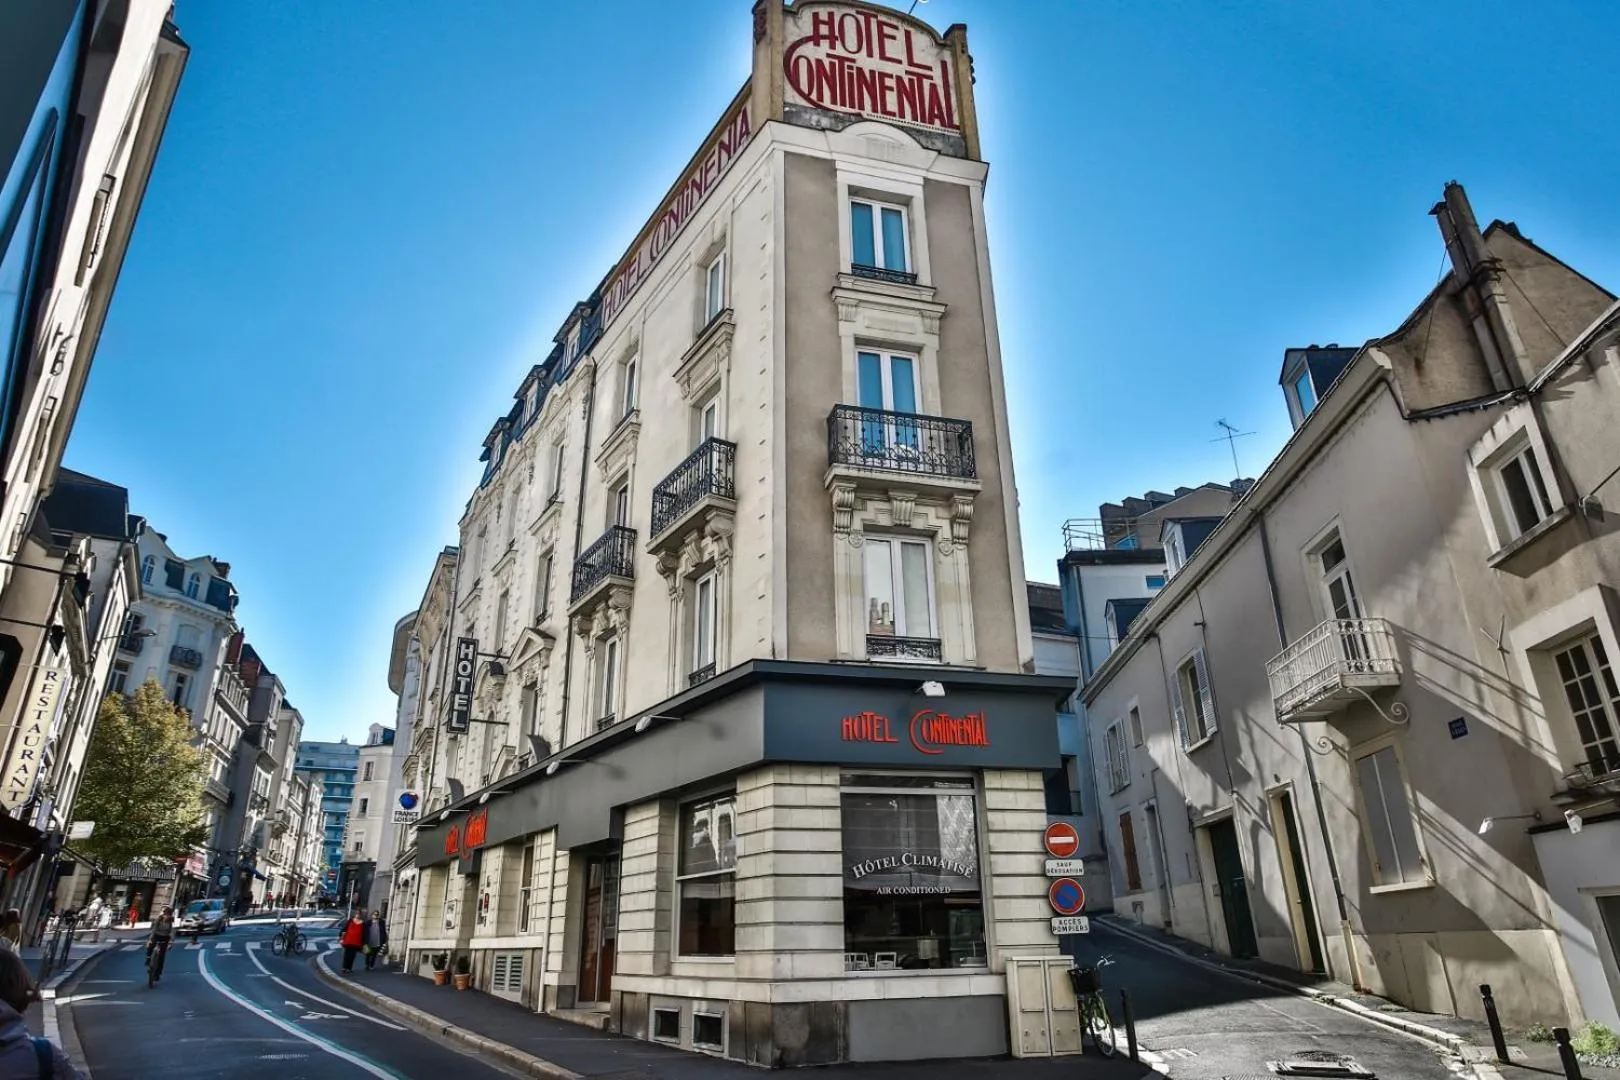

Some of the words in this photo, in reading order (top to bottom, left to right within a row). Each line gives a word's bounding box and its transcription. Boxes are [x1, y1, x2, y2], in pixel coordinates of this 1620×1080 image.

[812, 10, 932, 71] HOTEL
[783, 35, 960, 130] CONTINENTAL
[604, 250, 650, 321] HOTEL
[452, 643, 474, 728] HOTEL
[8, 671, 57, 802] RESTAURANT
[841, 711, 899, 743] HOTEL
[909, 708, 992, 755] CONTINENTAL
[852, 855, 900, 879] HÔTEL
[877, 886, 891, 894] AIR
[893, 886, 951, 894] CONDITIONED
